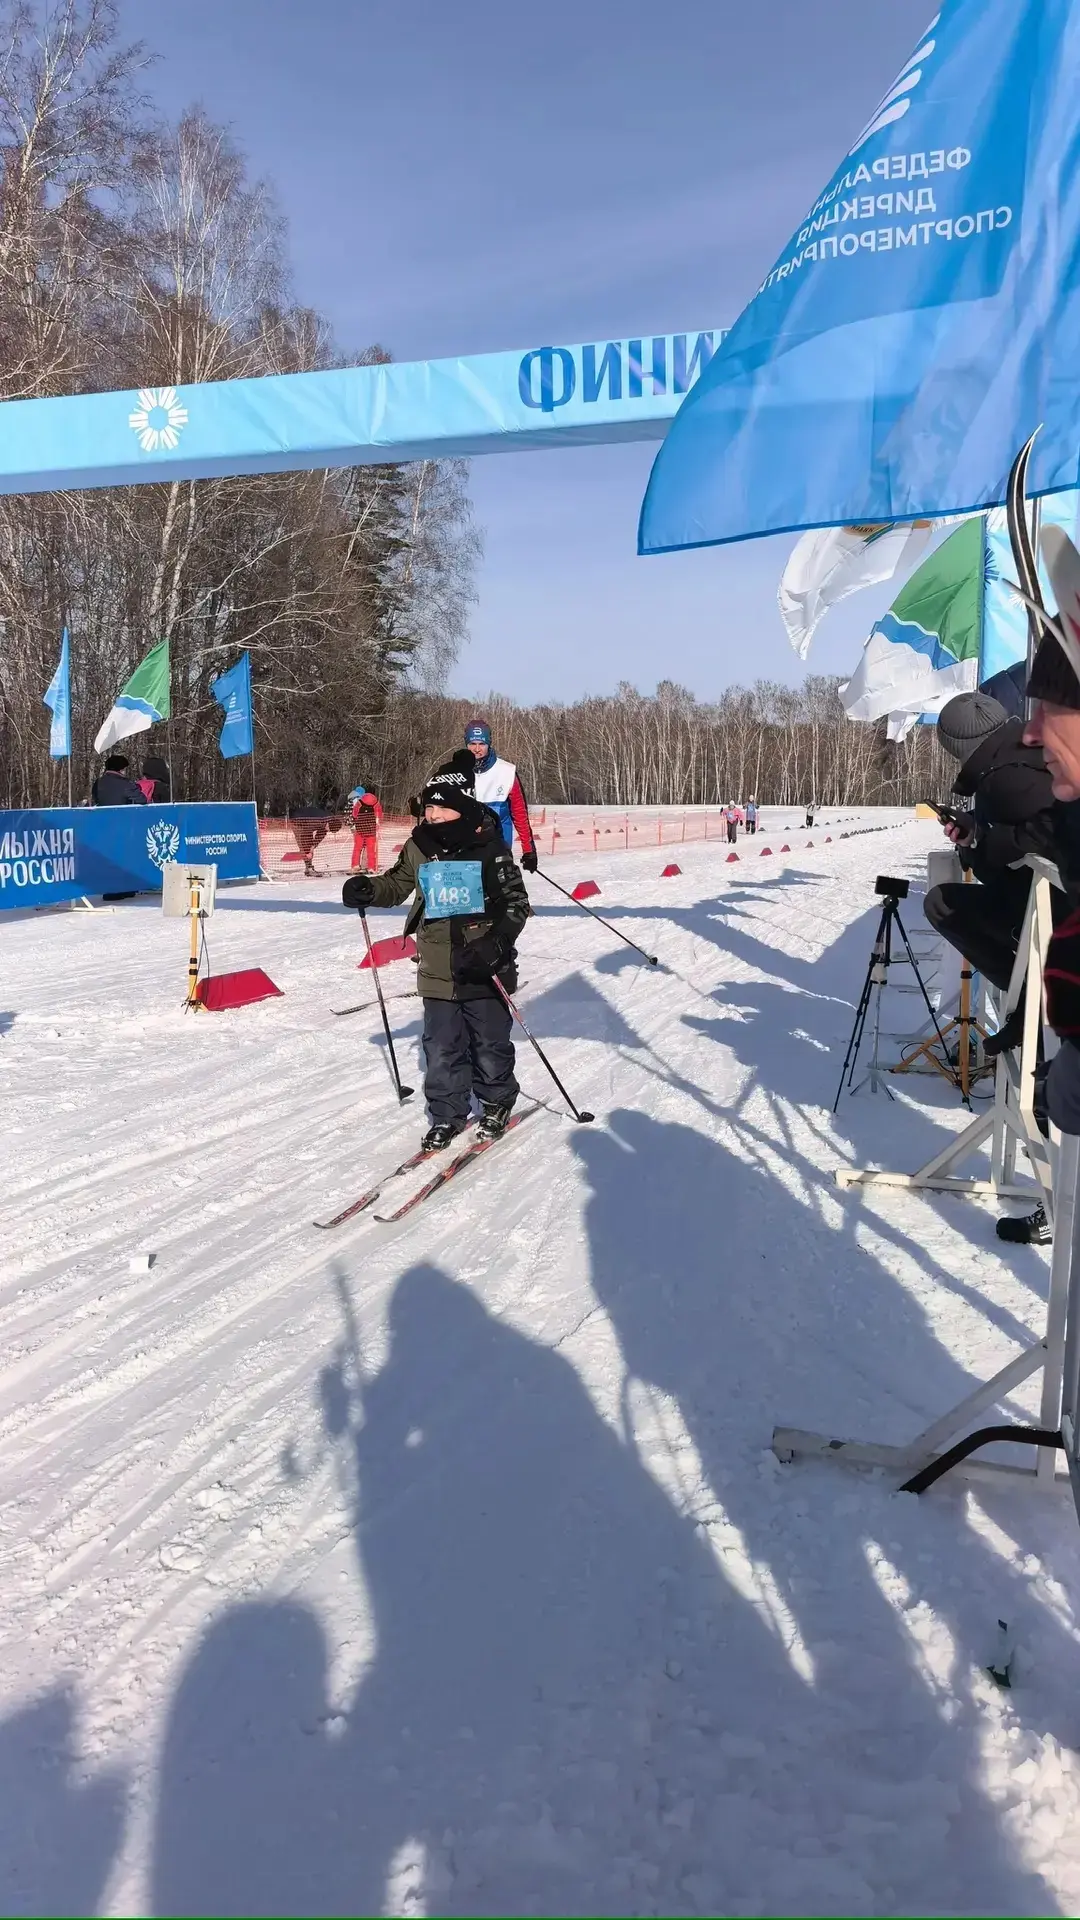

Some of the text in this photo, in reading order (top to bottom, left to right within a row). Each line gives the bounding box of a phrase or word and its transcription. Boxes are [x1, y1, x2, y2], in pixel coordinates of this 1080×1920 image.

[518, 330, 730, 412] ФИНИ
[0, 828, 75, 860] ЛЫЖНЯ
[185, 833, 247, 845] МИНИСТЕРСТВО СПОРТА
[205, 846, 228, 856] РОССИИ
[0, 856, 75, 888] РОССИИ
[428, 886, 471, 908] 1483
